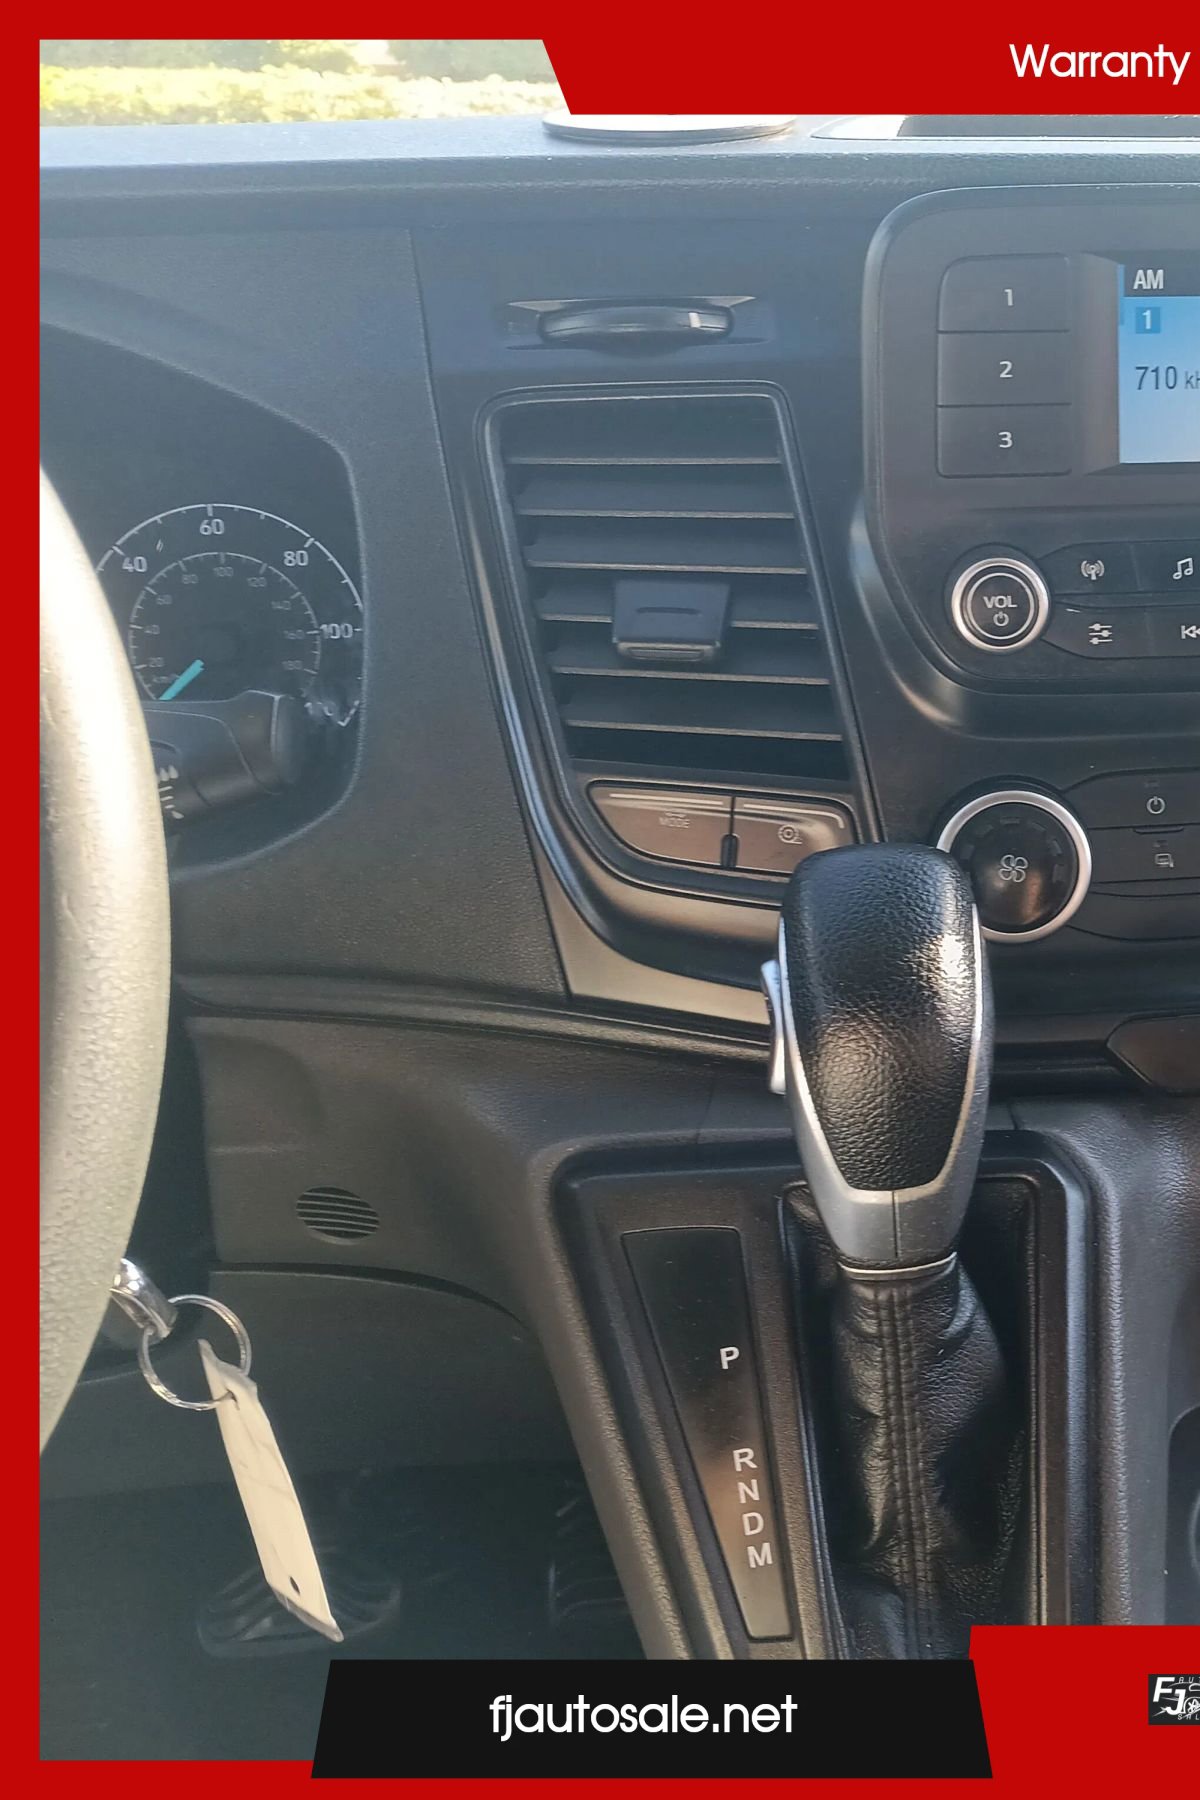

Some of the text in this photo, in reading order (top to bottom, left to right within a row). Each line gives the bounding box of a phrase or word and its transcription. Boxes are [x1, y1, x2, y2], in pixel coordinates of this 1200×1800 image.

[1133, 269, 1165, 290] AM
[1003, 287, 1014, 307] 1
[1142, 309, 1153, 330] 1
[999, 360, 1013, 379] 2
[1135, 366, 1178, 390] 710
[999, 431, 1013, 449] 3
[200, 519, 225, 535] 60
[122, 556, 148, 573] 40
[283, 551, 309, 566] 80
[983, 595, 1018, 609] VOL
[319, 624, 353, 639] 100
[719, 1346, 740, 1369] P
[733, 1448, 757, 1471] R
[738, 1480, 759, 1502] N
[743, 1513, 764, 1536] D
[747, 1542, 773, 1568] M
